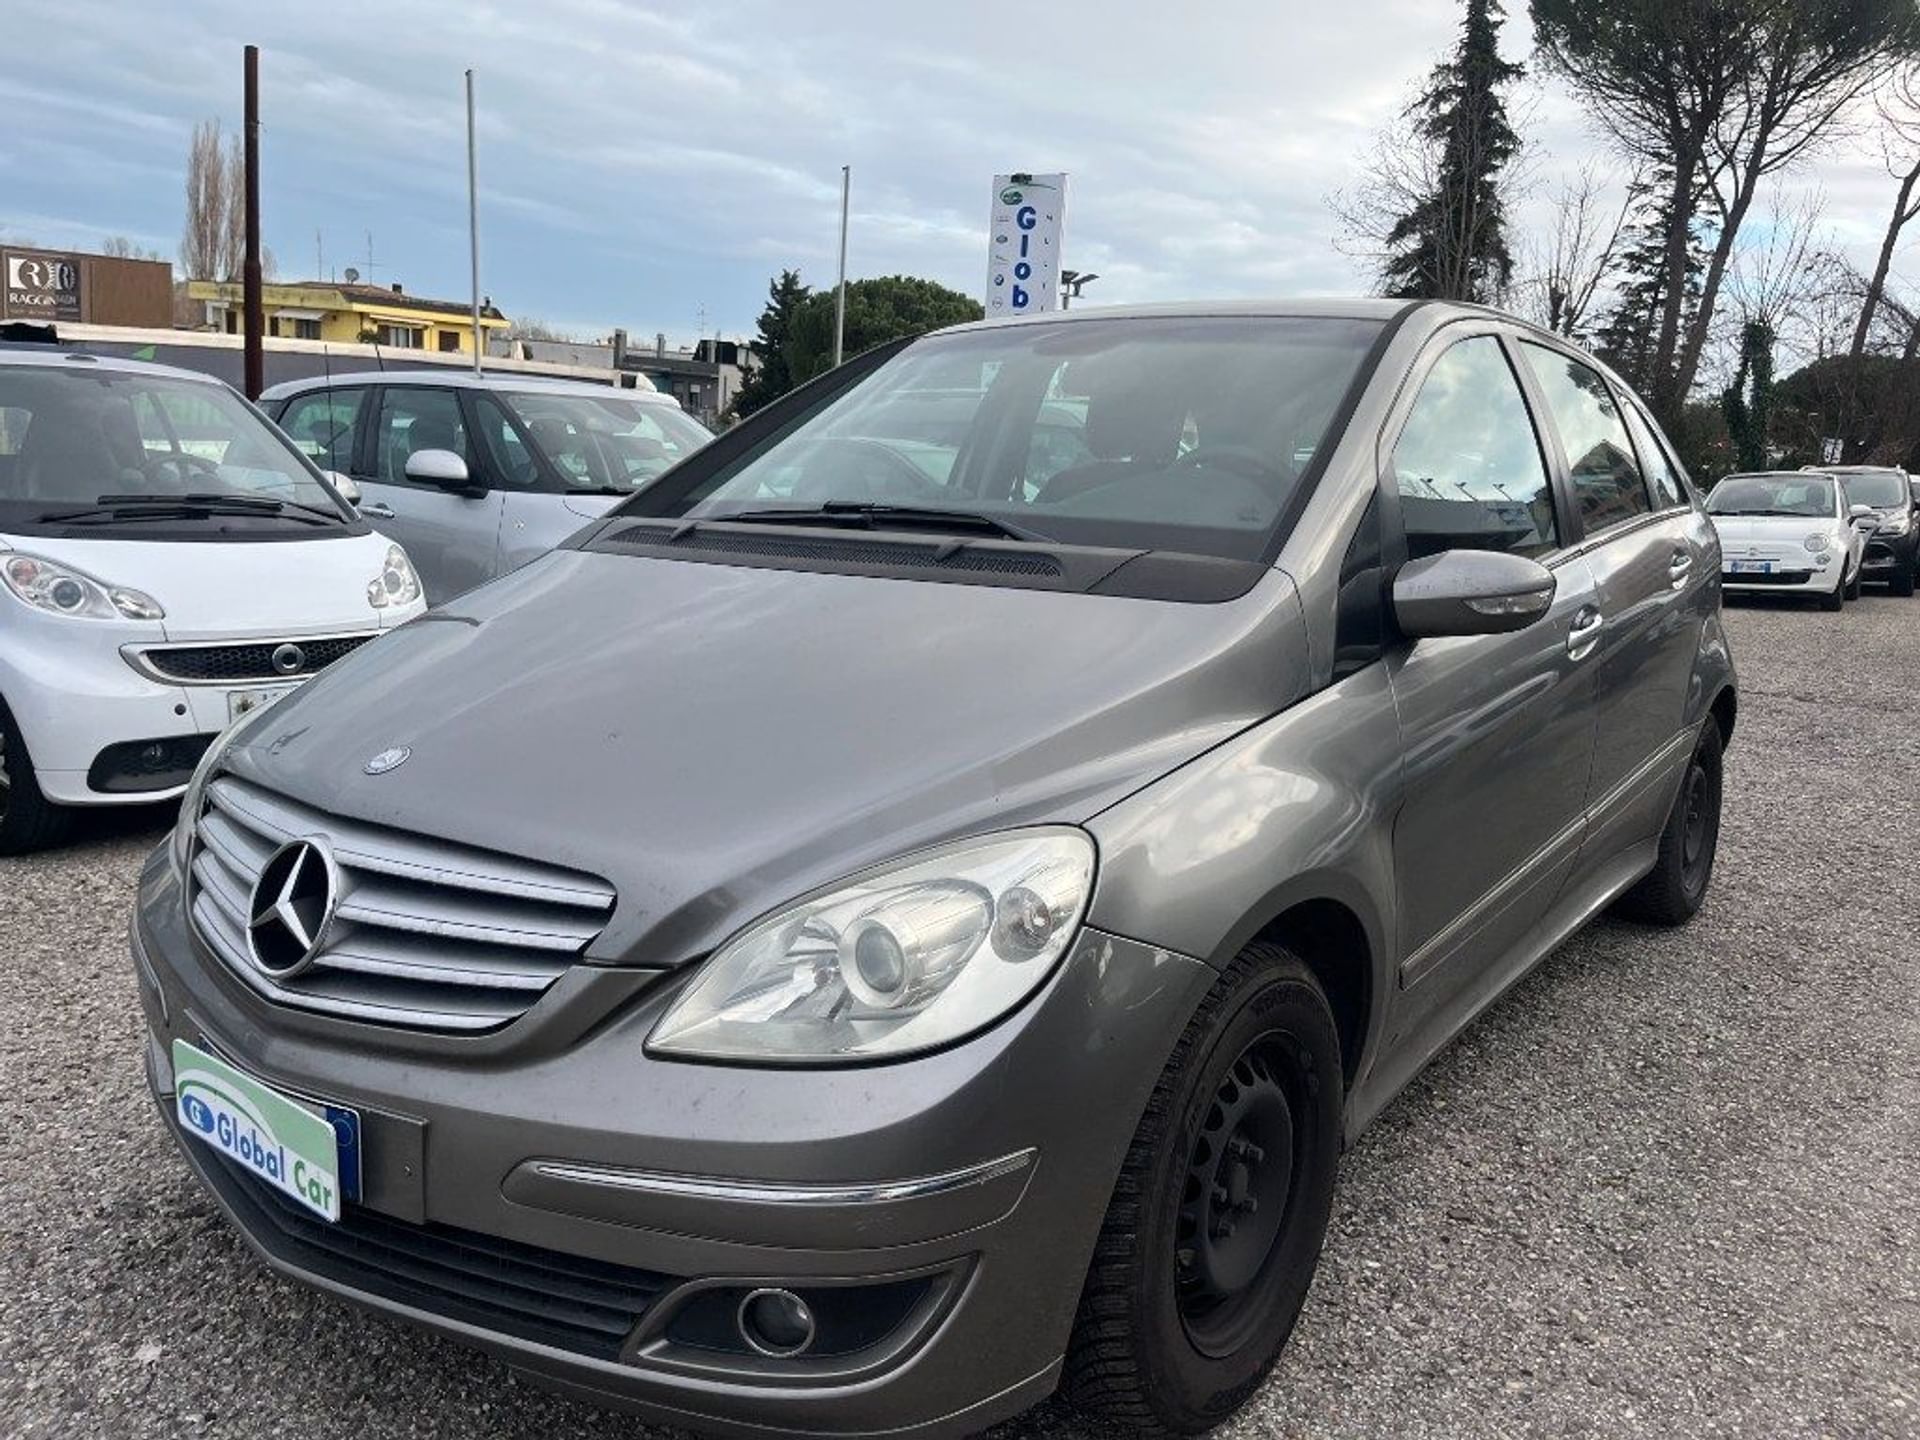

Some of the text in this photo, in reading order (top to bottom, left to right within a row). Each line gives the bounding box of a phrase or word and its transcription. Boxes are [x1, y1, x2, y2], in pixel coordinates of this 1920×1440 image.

[1012, 206, 1037, 315] Glob
[217, 1111, 332, 1211] Global Car
